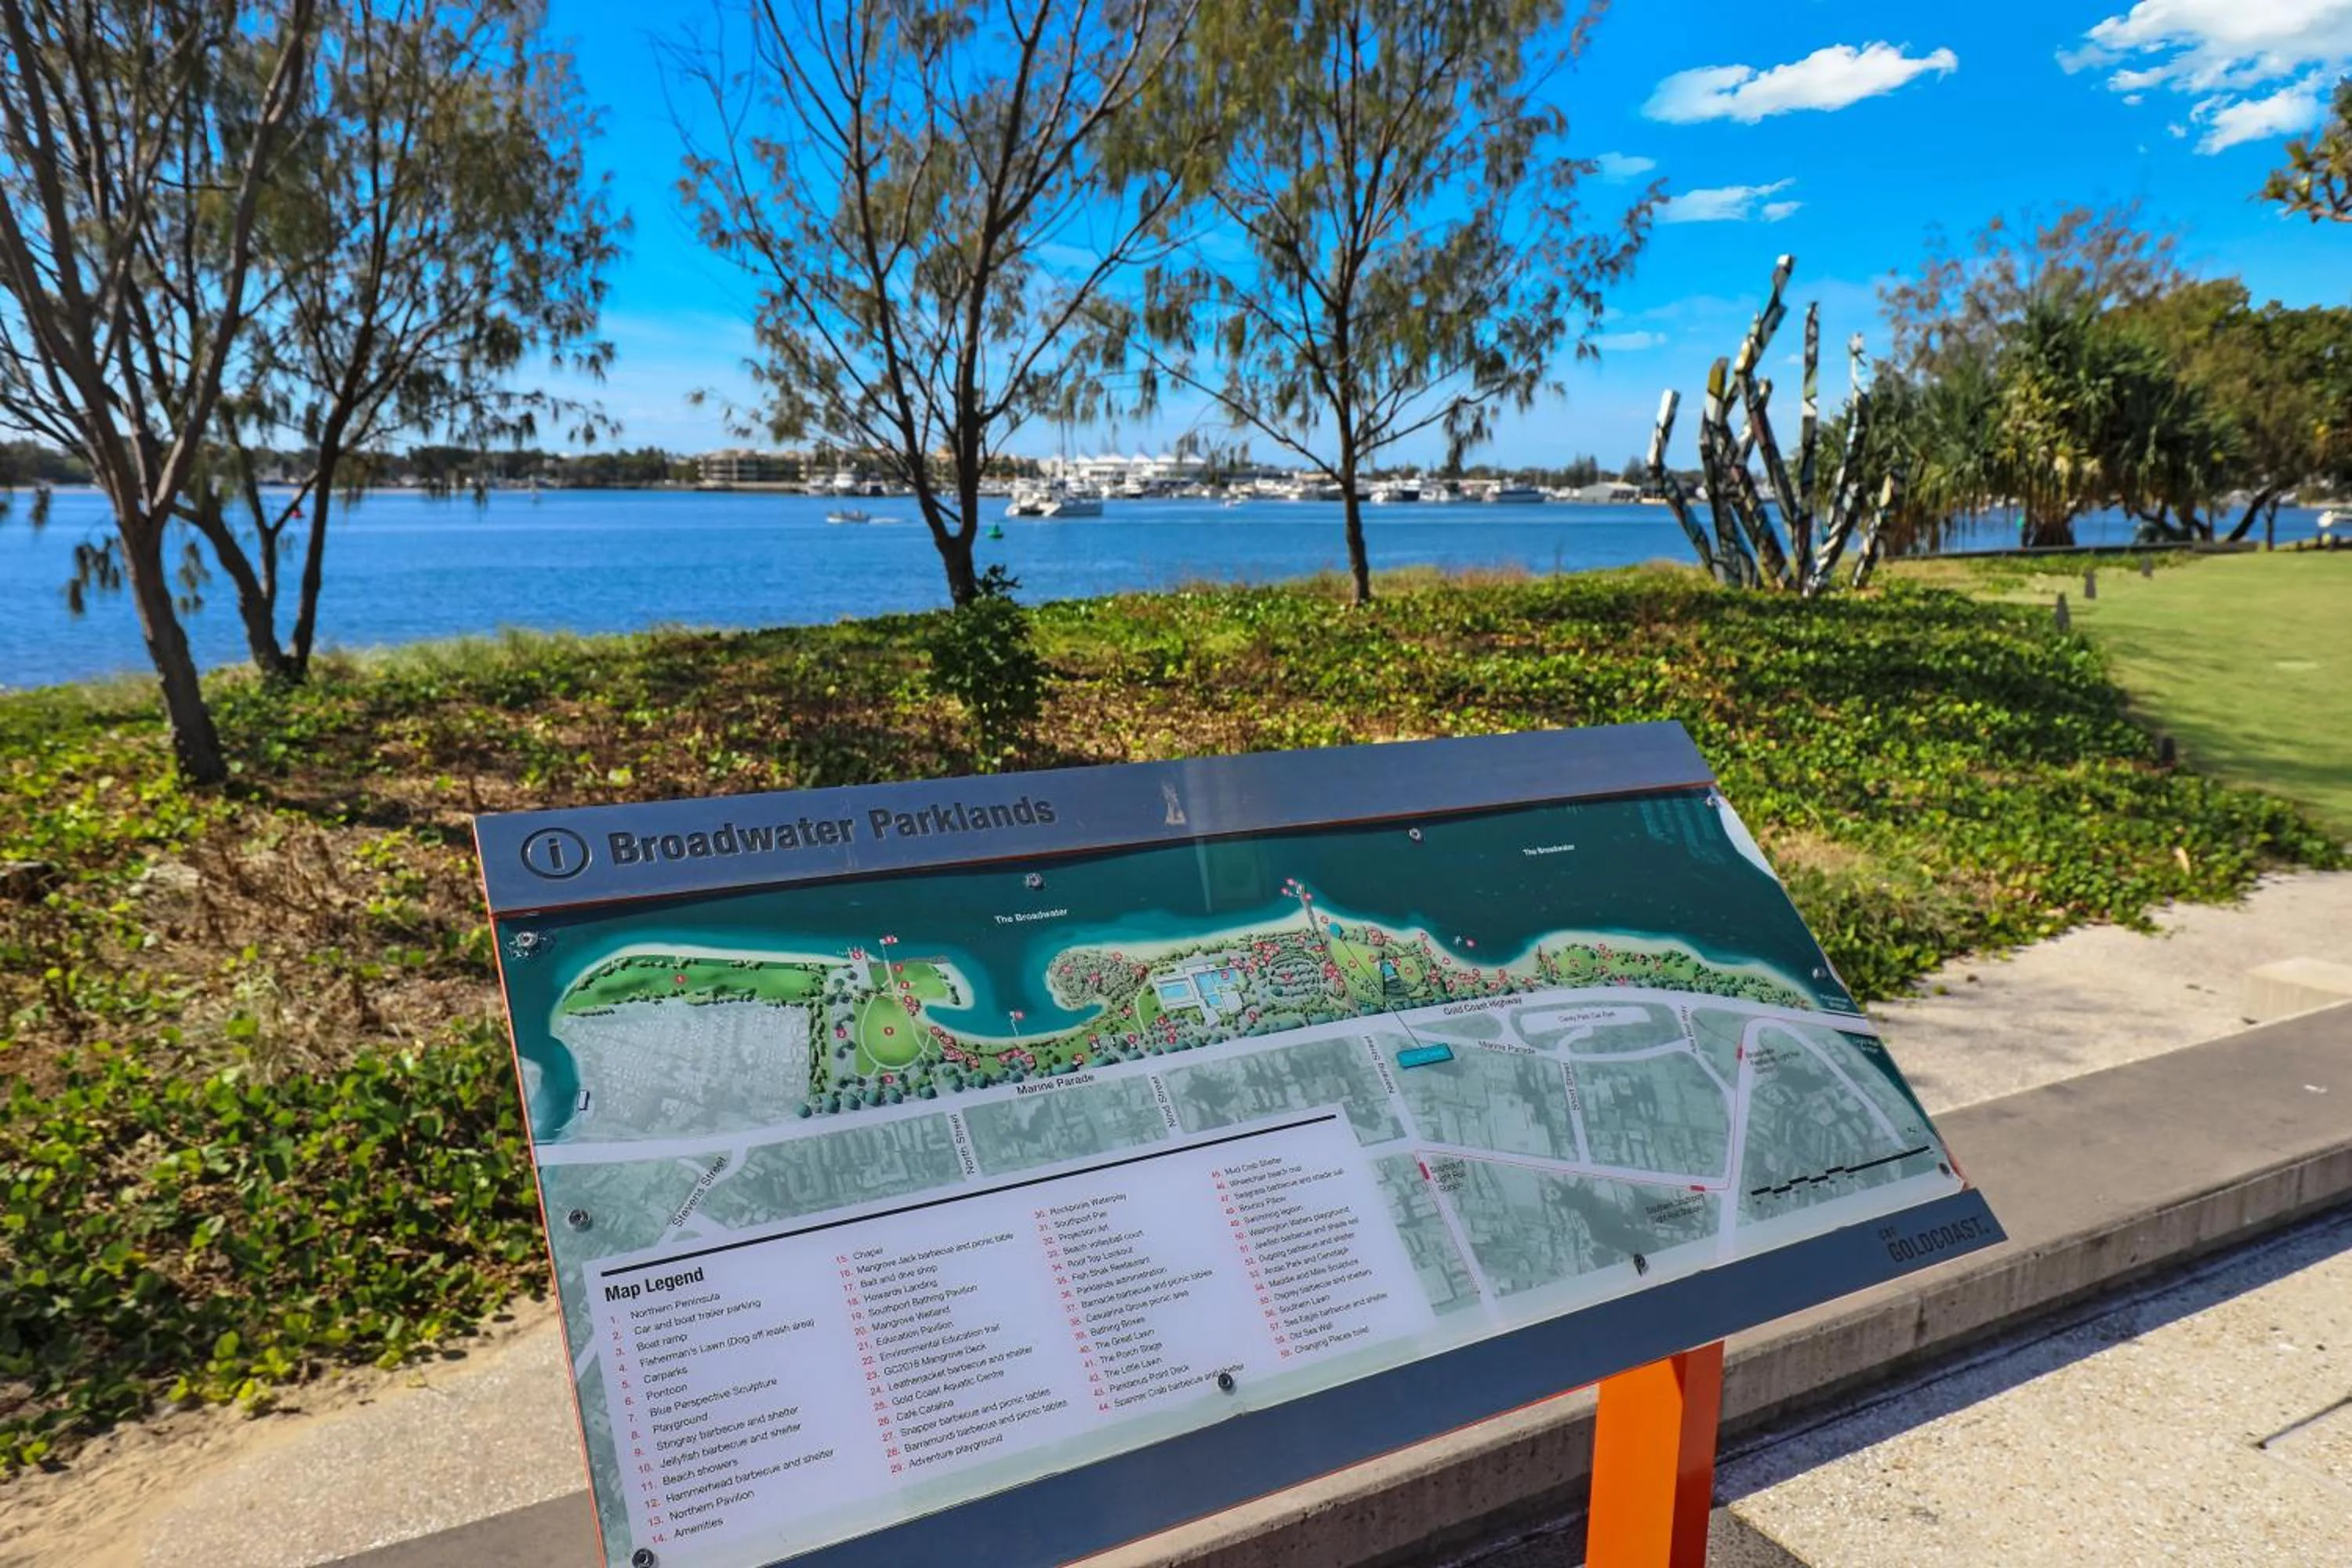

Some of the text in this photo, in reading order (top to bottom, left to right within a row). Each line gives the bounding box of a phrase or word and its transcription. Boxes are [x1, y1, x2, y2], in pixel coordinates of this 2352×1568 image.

[609, 818, 854, 865] Broadwater
[868, 796, 1056, 840] Parklands
[1014, 908, 1067, 921] Broadwater
[1017, 1074, 1094, 1095] Marine Parade
[959, 1148, 975, 1175] North
[673, 1157, 727, 1227] Stevens Street
[1888, 1217, 1991, 1263] GOLDCOAST.
[605, 1267, 705, 1301] Map Legend
[634, 1326, 650, 1334] Car
[655, 1319, 672, 1330] and
[988, 1353, 1004, 1363] and
[646, 1384, 687, 1400] Pontoon
[650, 1406, 672, 1416] Blue
[981, 1402, 997, 1413] and
[747, 1414, 765, 1426] and
[999, 1413, 1014, 1424] and
[750, 1431, 768, 1442] and
[784, 1457, 800, 1468] and
[663, 1469, 695, 1485] Beach
[670, 1502, 714, 1520] Northern
